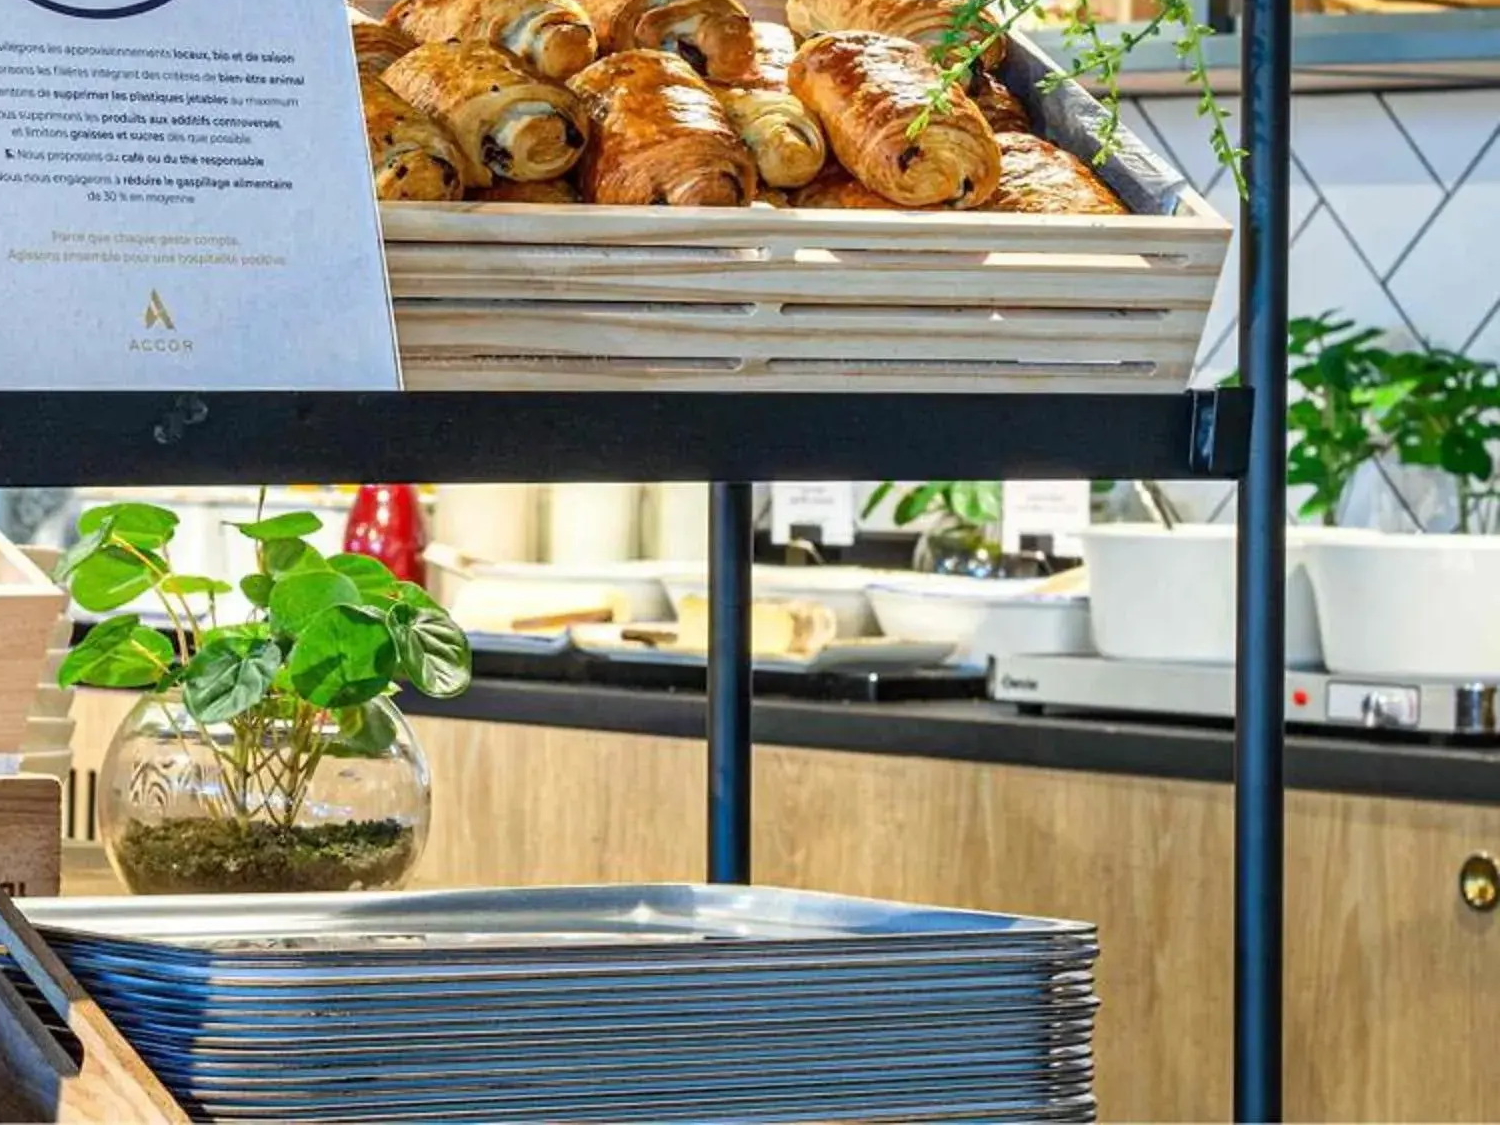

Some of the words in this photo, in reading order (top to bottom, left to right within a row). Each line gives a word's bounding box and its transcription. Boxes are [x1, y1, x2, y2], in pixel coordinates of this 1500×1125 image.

[212, 50, 230, 61] bio
[232, 51, 243, 62] et
[245, 51, 258, 62] de
[261, 51, 295, 64] saison
[36, 65, 52, 76] les
[269, 75, 305, 85] animal
[38, 88, 51, 98] de
[53, 89, 109, 101] supprimer
[111, 91, 127, 101] les
[129, 92, 184, 104] plastiques
[101, 113, 146, 125] produits
[150, 115, 168, 125] aux
[11, 127, 23, 137] et
[70, 128, 114, 141] graisses
[116, 130, 128, 140] et
[130, 131, 164, 142] sucres
[17, 149, 44, 160] Nous
[121, 152, 144, 163] café
[146, 154, 160, 164] ou
[163, 154, 177, 164] du
[200, 155, 264, 167] responsable
[24, 173, 50, 183] nous
[123, 174, 162, 186] réduire
[163, 176, 174, 186] le
[176, 176, 230, 190] gaspillage
[233, 178, 293, 189] alimentaire
[87, 191, 100, 201] de
[103, 191, 117, 202] 30
[130, 193, 144, 202] en
[146, 193, 195, 205] moyenne
[129, 339, 194, 353] ACCOR
